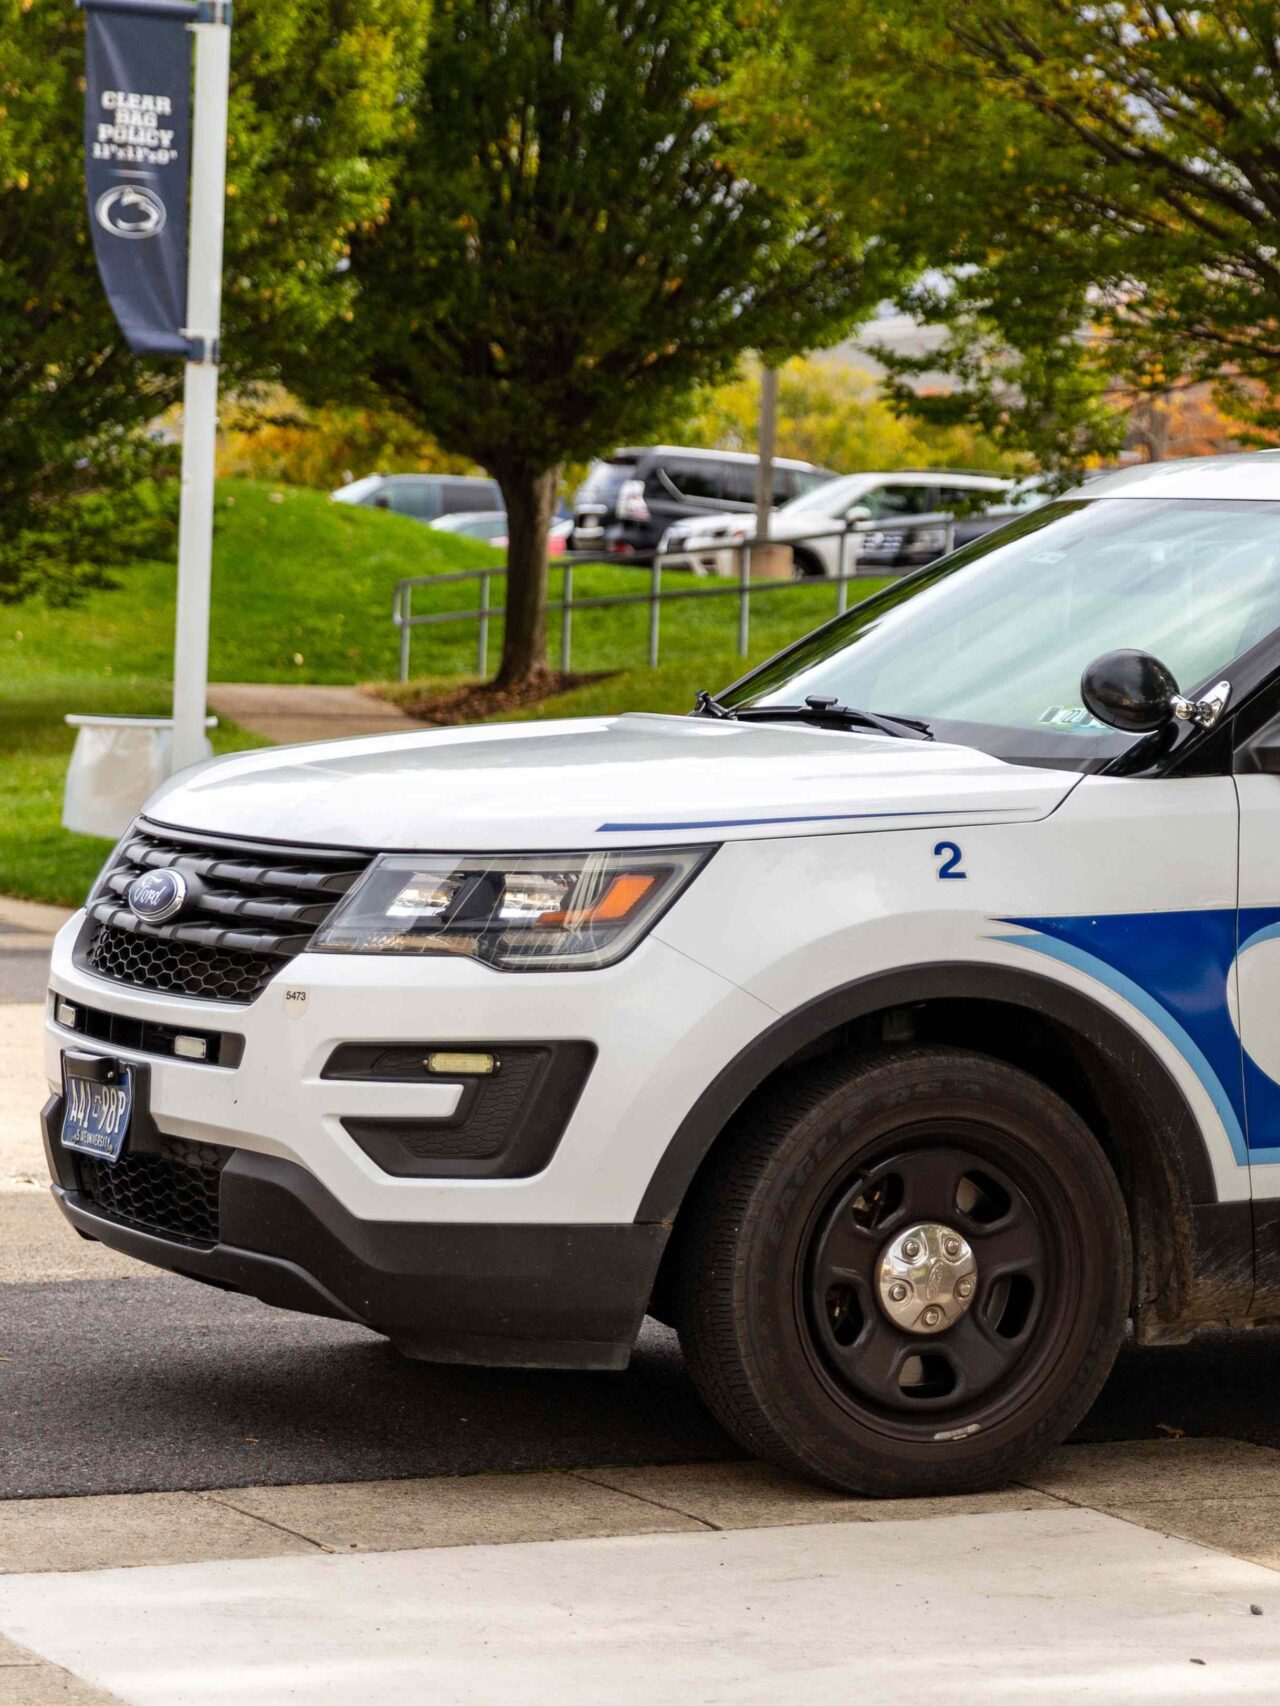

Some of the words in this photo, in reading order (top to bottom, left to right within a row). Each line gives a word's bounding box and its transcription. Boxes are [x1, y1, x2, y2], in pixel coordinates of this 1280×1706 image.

[101, 90, 171, 116] CLEAR
[115, 108, 158, 128] BAG
[97, 123, 175, 149] POLICY
[933, 840, 968, 879] 2
[133, 875, 167, 906] Ford
[285, 990, 307, 1001] 5473
